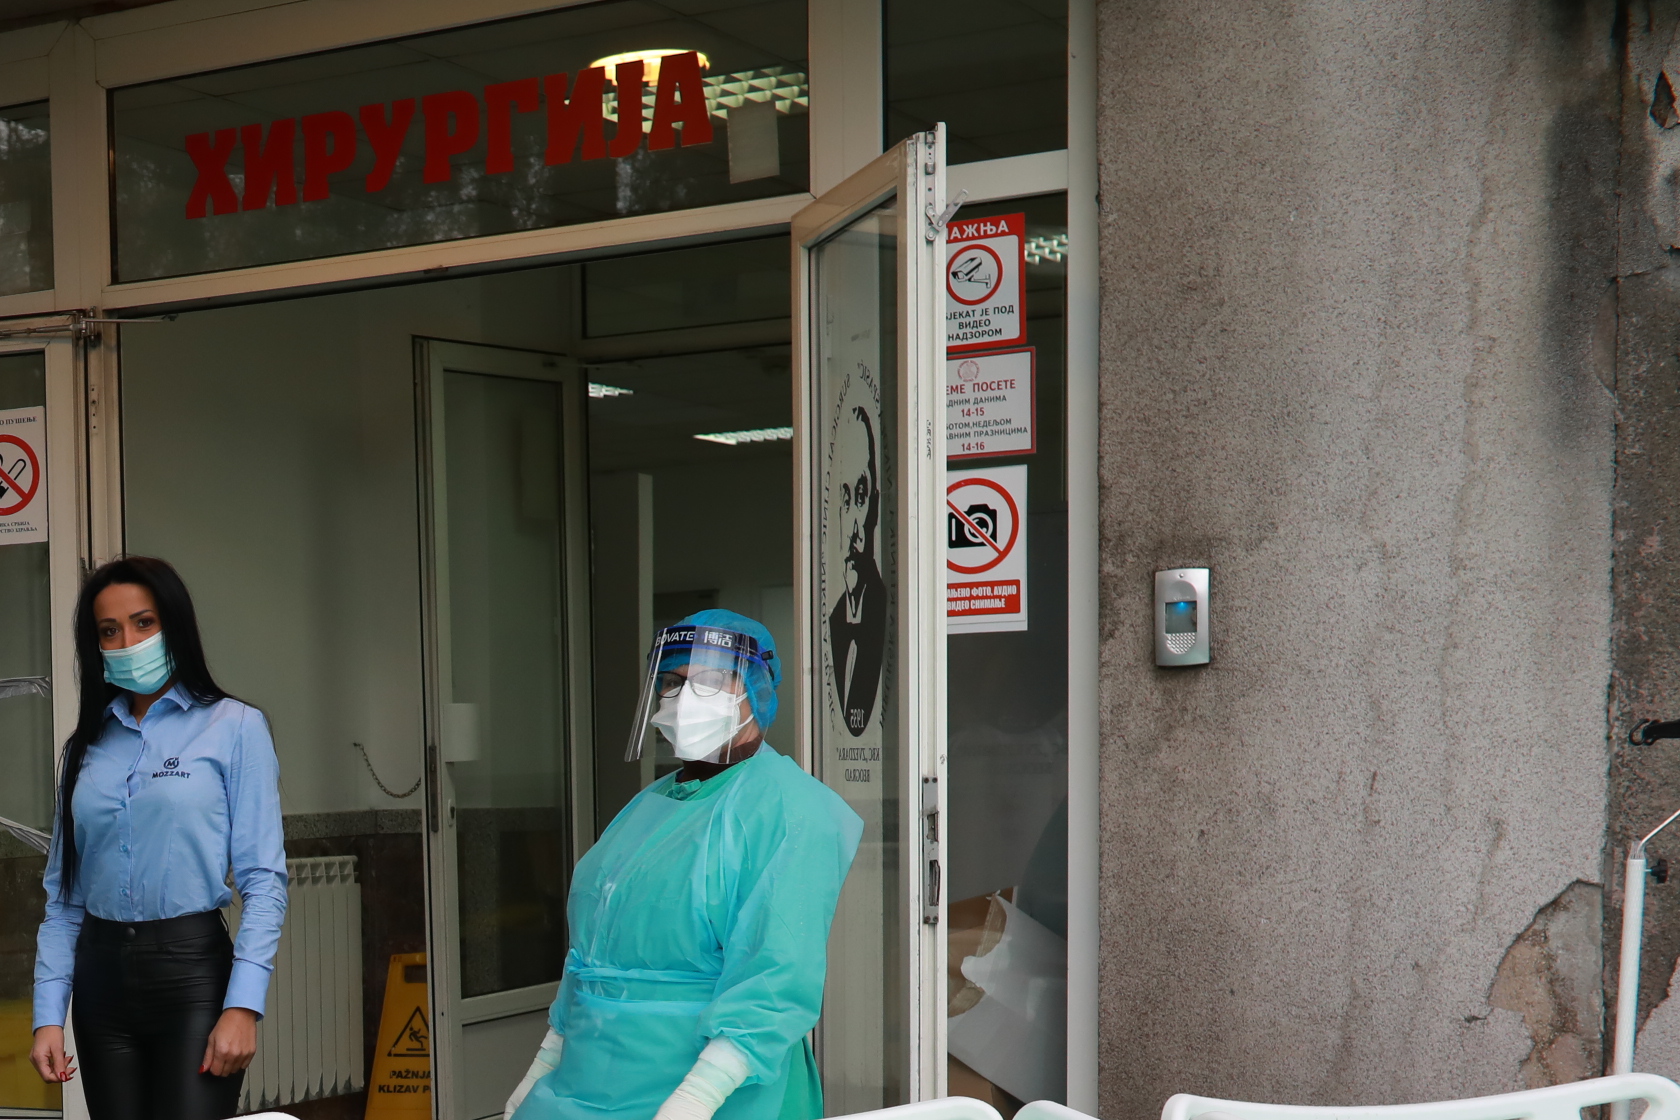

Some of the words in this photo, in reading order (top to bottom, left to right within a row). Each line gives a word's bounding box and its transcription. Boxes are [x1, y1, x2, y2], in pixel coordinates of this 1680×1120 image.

[184, 50, 714, 220] ХИРУРГИЈА
[946, 219, 1010, 240] АЖЊА
[980, 307, 990, 317] ЈЕ
[993, 304, 1015, 315] ПОД
[958, 318, 991, 330] ВИДЕО
[947, 327, 1003, 342] НАДЗОРОМ
[972, 379, 1016, 393] ПОСЕТЕ
[972, 395, 1008, 406] ДАНИМА
[961, 406, 985, 418] 14-15
[5, 415, 38, 426] ПУШЕЊЕ
[973, 426, 1029, 438] ПРАЗНИЦИМА
[961, 441, 985, 452] 14-16
[994, 585, 1017, 596] АУДИО
[947, 600, 970, 611] ВИДЕО
[970, 598, 1006, 609] СНИМАЊЕ
[152, 770, 191, 779] MOZZART
[390, 1069, 432, 1079] PAŽNJA
[378, 1084, 420, 1094] KLIZAV
[422, 1085, 432, 1094] P
